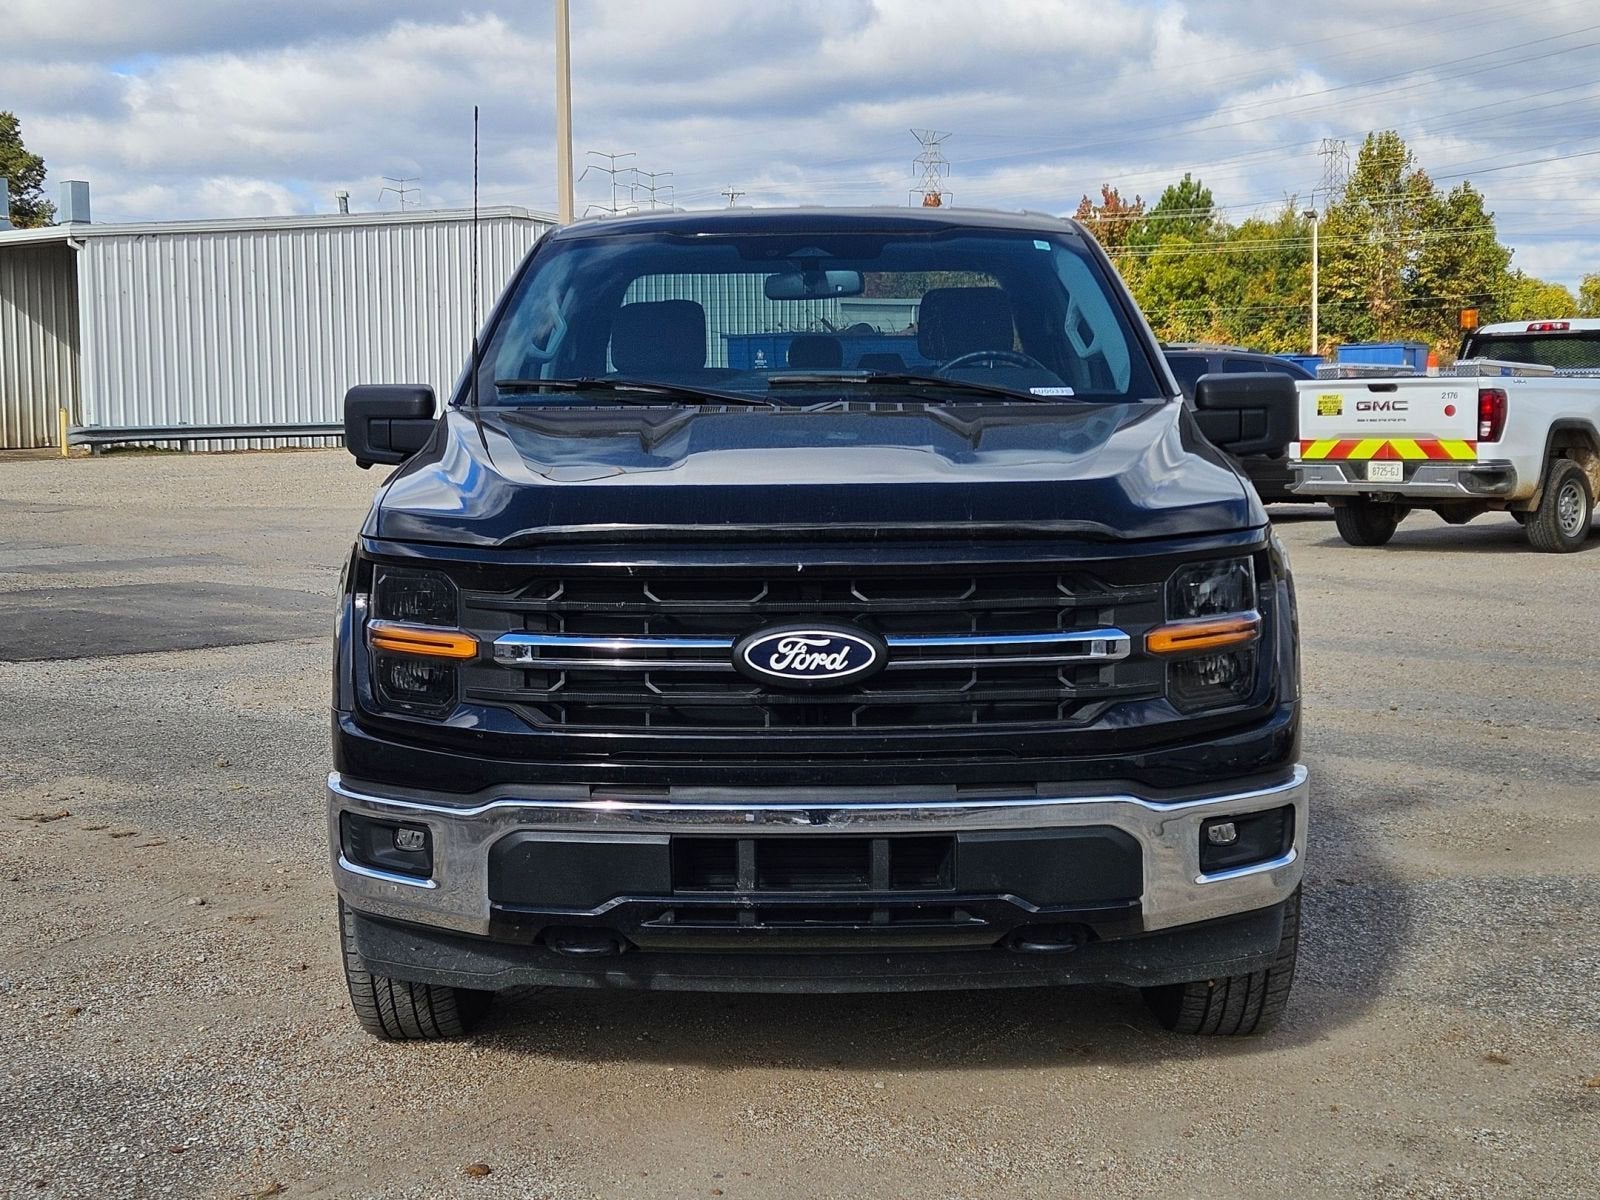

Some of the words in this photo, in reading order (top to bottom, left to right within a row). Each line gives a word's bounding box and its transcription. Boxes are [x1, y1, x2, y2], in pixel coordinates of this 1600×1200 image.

[1441, 391, 1458, 400] 2176
[1356, 400, 1409, 412] GMC
[769, 637, 851, 671] Ford
